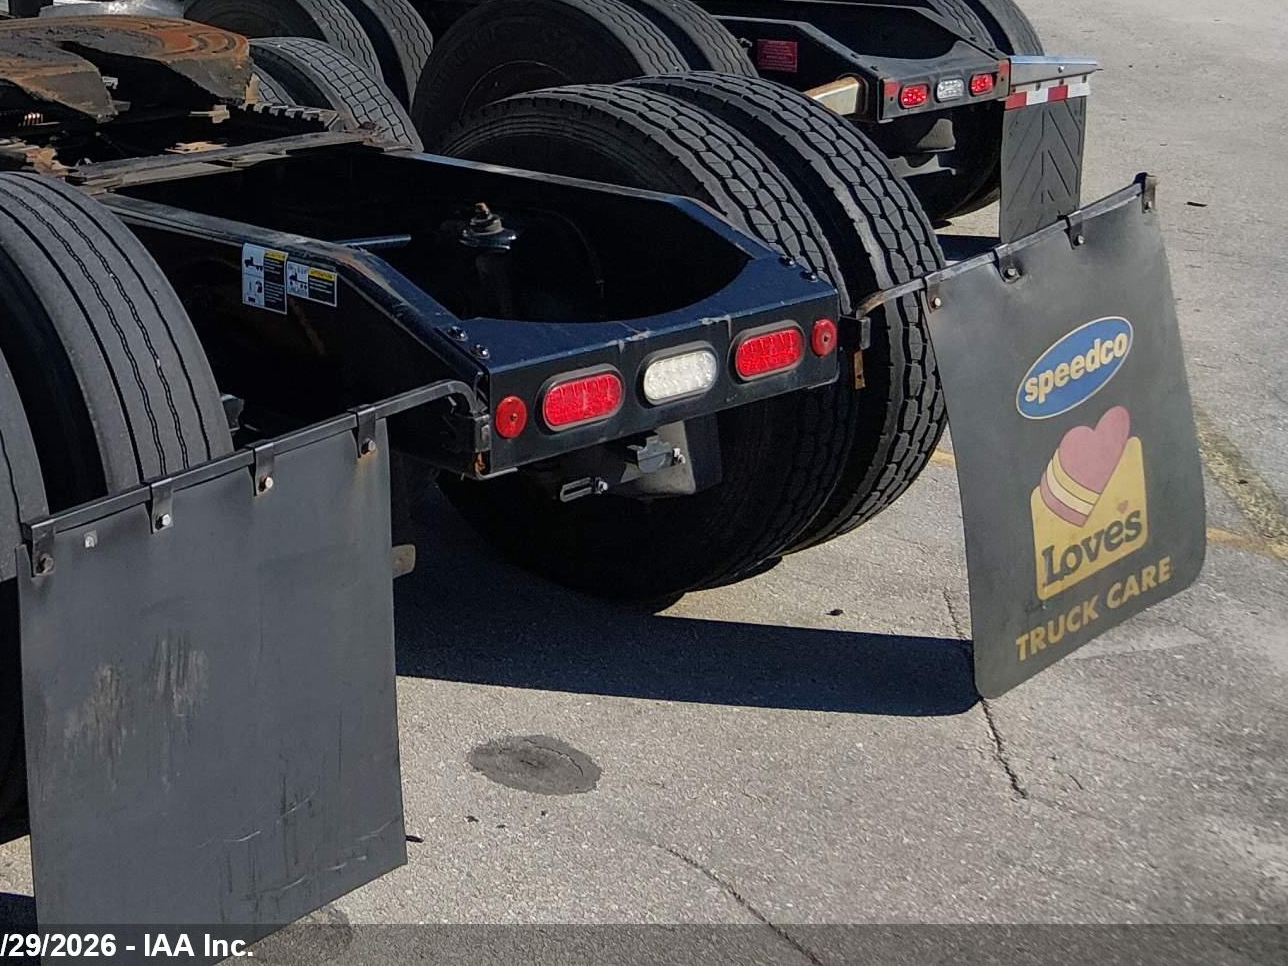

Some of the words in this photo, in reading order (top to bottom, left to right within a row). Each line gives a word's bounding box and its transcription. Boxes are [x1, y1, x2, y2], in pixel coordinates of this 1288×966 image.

[1024, 332, 1129, 404] speedco
[1016, 594, 1100, 661] TRUCK
[1106, 555, 1172, 609] CARE
